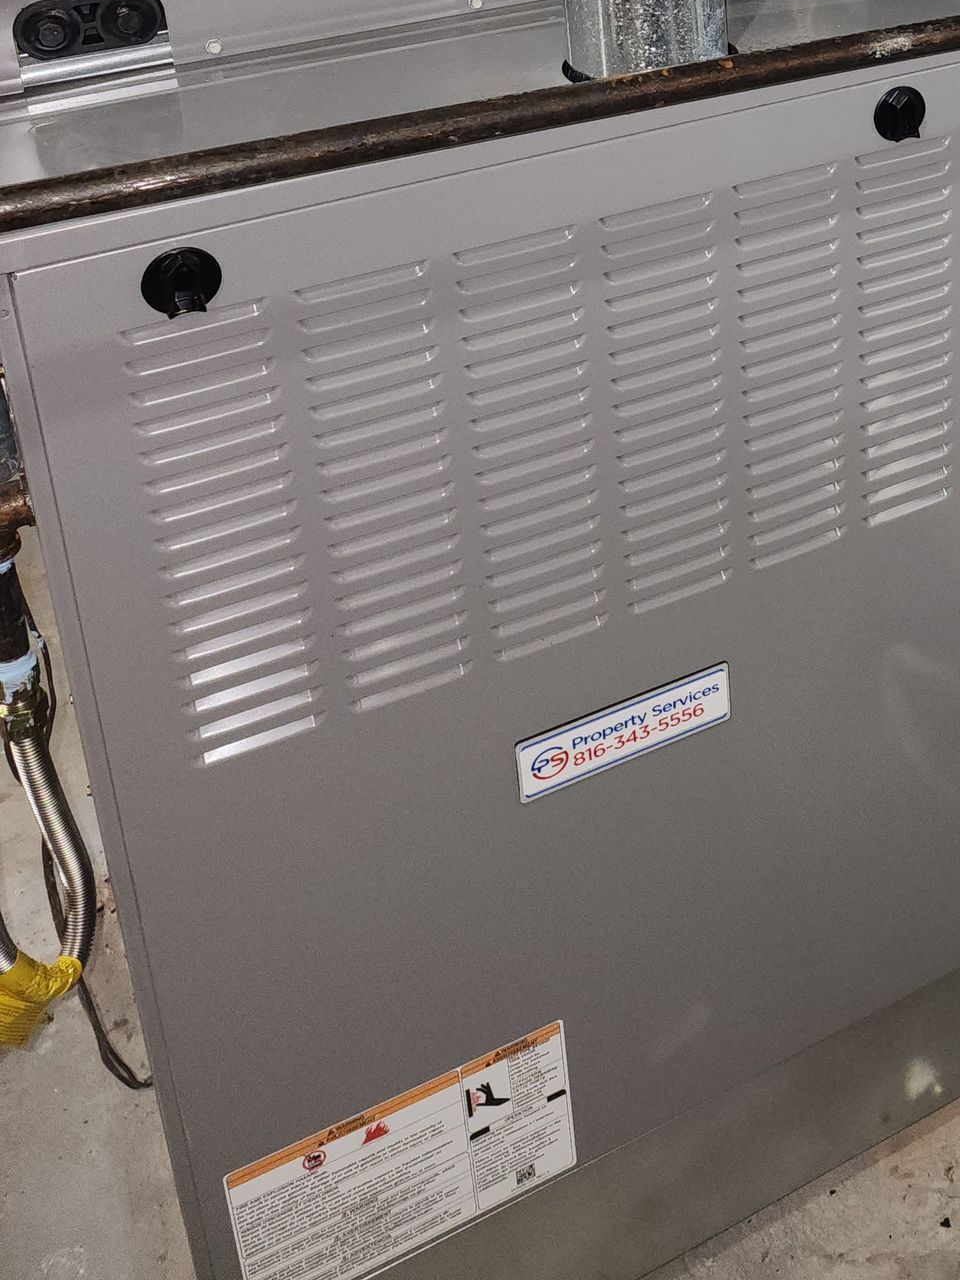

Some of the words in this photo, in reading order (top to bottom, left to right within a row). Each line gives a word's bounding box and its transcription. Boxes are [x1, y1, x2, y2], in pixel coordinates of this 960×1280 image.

[572, 712, 647, 749] Property
[651, 683, 720, 718] Services
[573, 703, 705, 767] 816-343-5556
